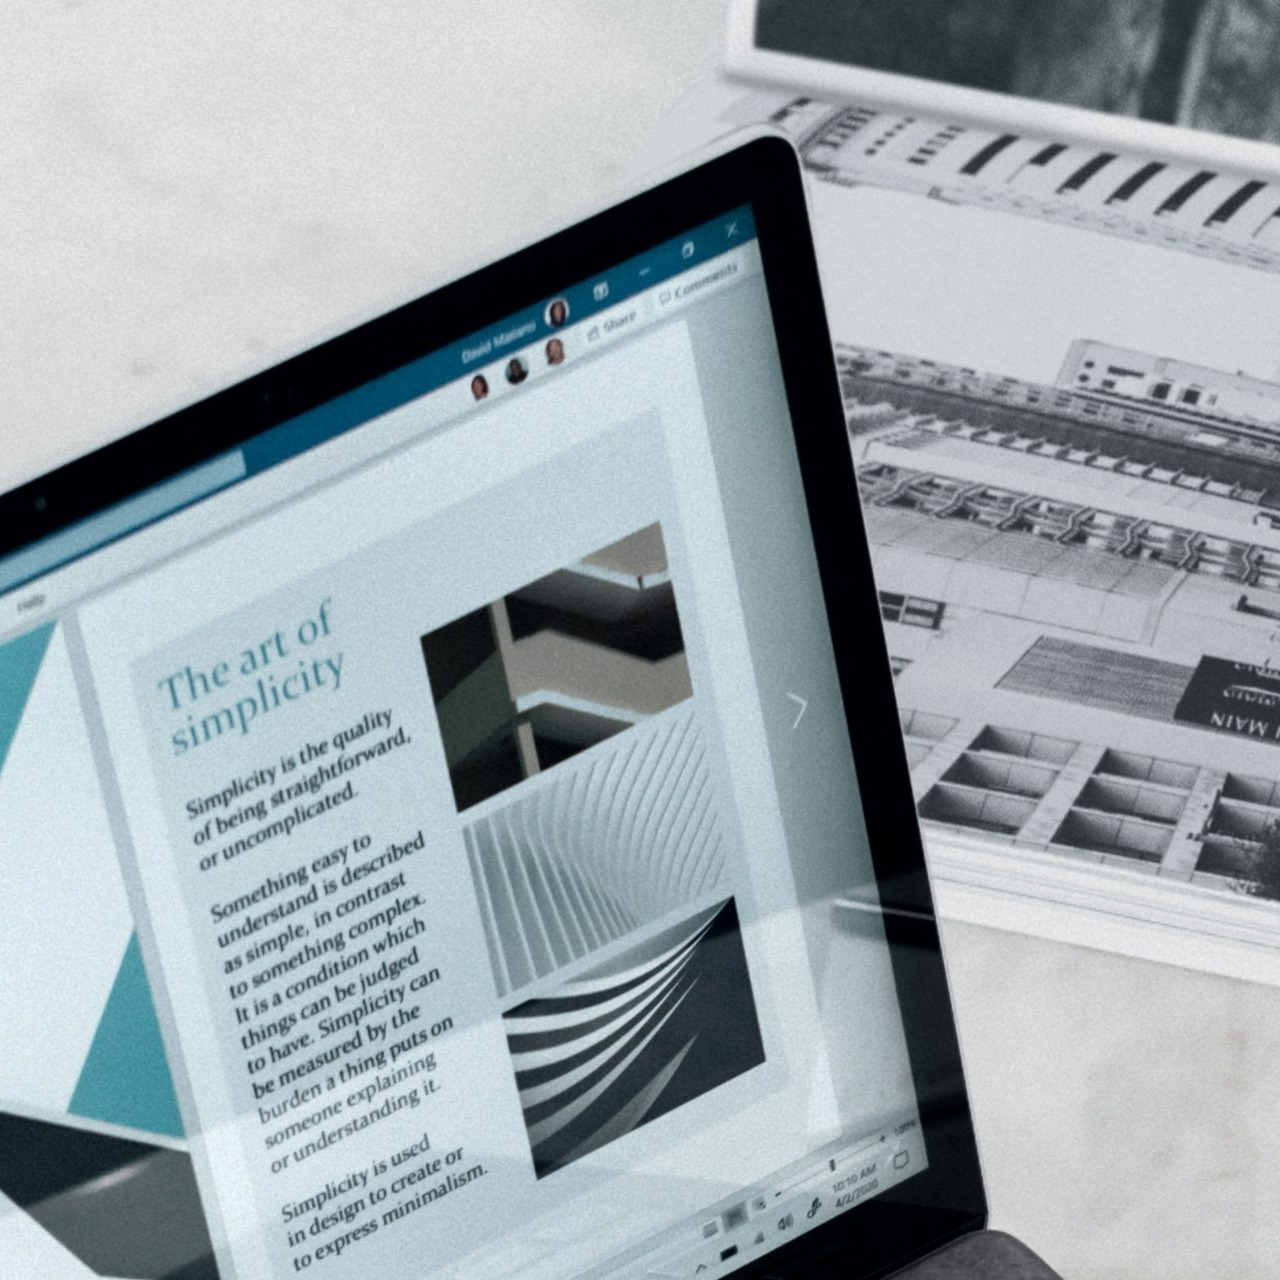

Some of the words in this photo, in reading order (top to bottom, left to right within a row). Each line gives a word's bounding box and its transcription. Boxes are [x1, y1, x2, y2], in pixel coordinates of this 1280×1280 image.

[603, 311, 637, 333] Share
[674, 263, 738, 300] Comments
[158, 662, 229, 710] The
[240, 631, 287, 676] art
[297, 597, 331, 646] of
[172, 652, 343, 751] simplicity
[185, 766, 276, 820] Simplicity
[280, 756, 297, 774] is
[298, 740, 329, 765] the
[332, 709, 392, 750] quality
[1210, 711, 1269, 737] MAIN
[192, 821, 212, 846] of
[215, 800, 268, 835] being
[270, 726, 412, 808] straightforward,
[199, 852, 218, 872] or
[222, 780, 358, 861] uncomplicated.
[210, 865, 309, 924] Something
[311, 845, 349, 874] easy
[352, 834, 372, 854] to
[217, 884, 319, 949] understand
[322, 879, 338, 896] is
[340, 829, 426, 887] described
[223, 955, 243, 975] as
[245, 924, 310, 963] simple,
[314, 910, 333, 929] in
[335, 871, 407, 918] contrast
[228, 981, 249, 1000] to
[251, 931, 346, 989] something
[348, 894, 426, 940] complex.
[234, 1007, 250, 1025] It
[253, 998, 270, 1016] is
[271, 992, 283, 1007] a
[284, 947, 370, 1000] condition
[372, 917, 427, 955] which
[240, 1013, 298, 1051] things
[299, 995, 332, 1021] can
[333, 982, 356, 1003] be
[359, 945, 420, 994] judged
[246, 1056, 267, 1075] to
[268, 1033, 315, 1064] have.
[318, 985, 405, 1039] Simplicity
[409, 967, 441, 993] can
[251, 1079, 275, 1100] be
[278, 1030, 363, 1087] measured
[366, 1022, 387, 1042] by
[391, 1005, 421, 1030] the
[257, 1083, 322, 1125] burden
[326, 1076, 336, 1091] a
[338, 1050, 387, 1084] thing
[388, 1029, 429, 1062] puts
[429, 1016, 455, 1038] on
[264, 1100, 343, 1150] someone
[345, 1052, 438, 1108] explaining
[270, 1154, 289, 1174] or
[292, 1088, 421, 1163] understanding
[423, 1079, 441, 1096] it.
[281, 1170, 368, 1224] Simplicity
[373, 1161, 388, 1177] is
[390, 1132, 431, 1168] used
[287, 1229, 307, 1248] in
[309, 1198, 366, 1236] design
[368, 1187, 388, 1206] to
[390, 1159, 442, 1194] create
[444, 1147, 463, 1166] or
[293, 1254, 313, 1272] to
[314, 1219, 379, 1261] express
[381, 1164, 489, 1226] minimalism.
